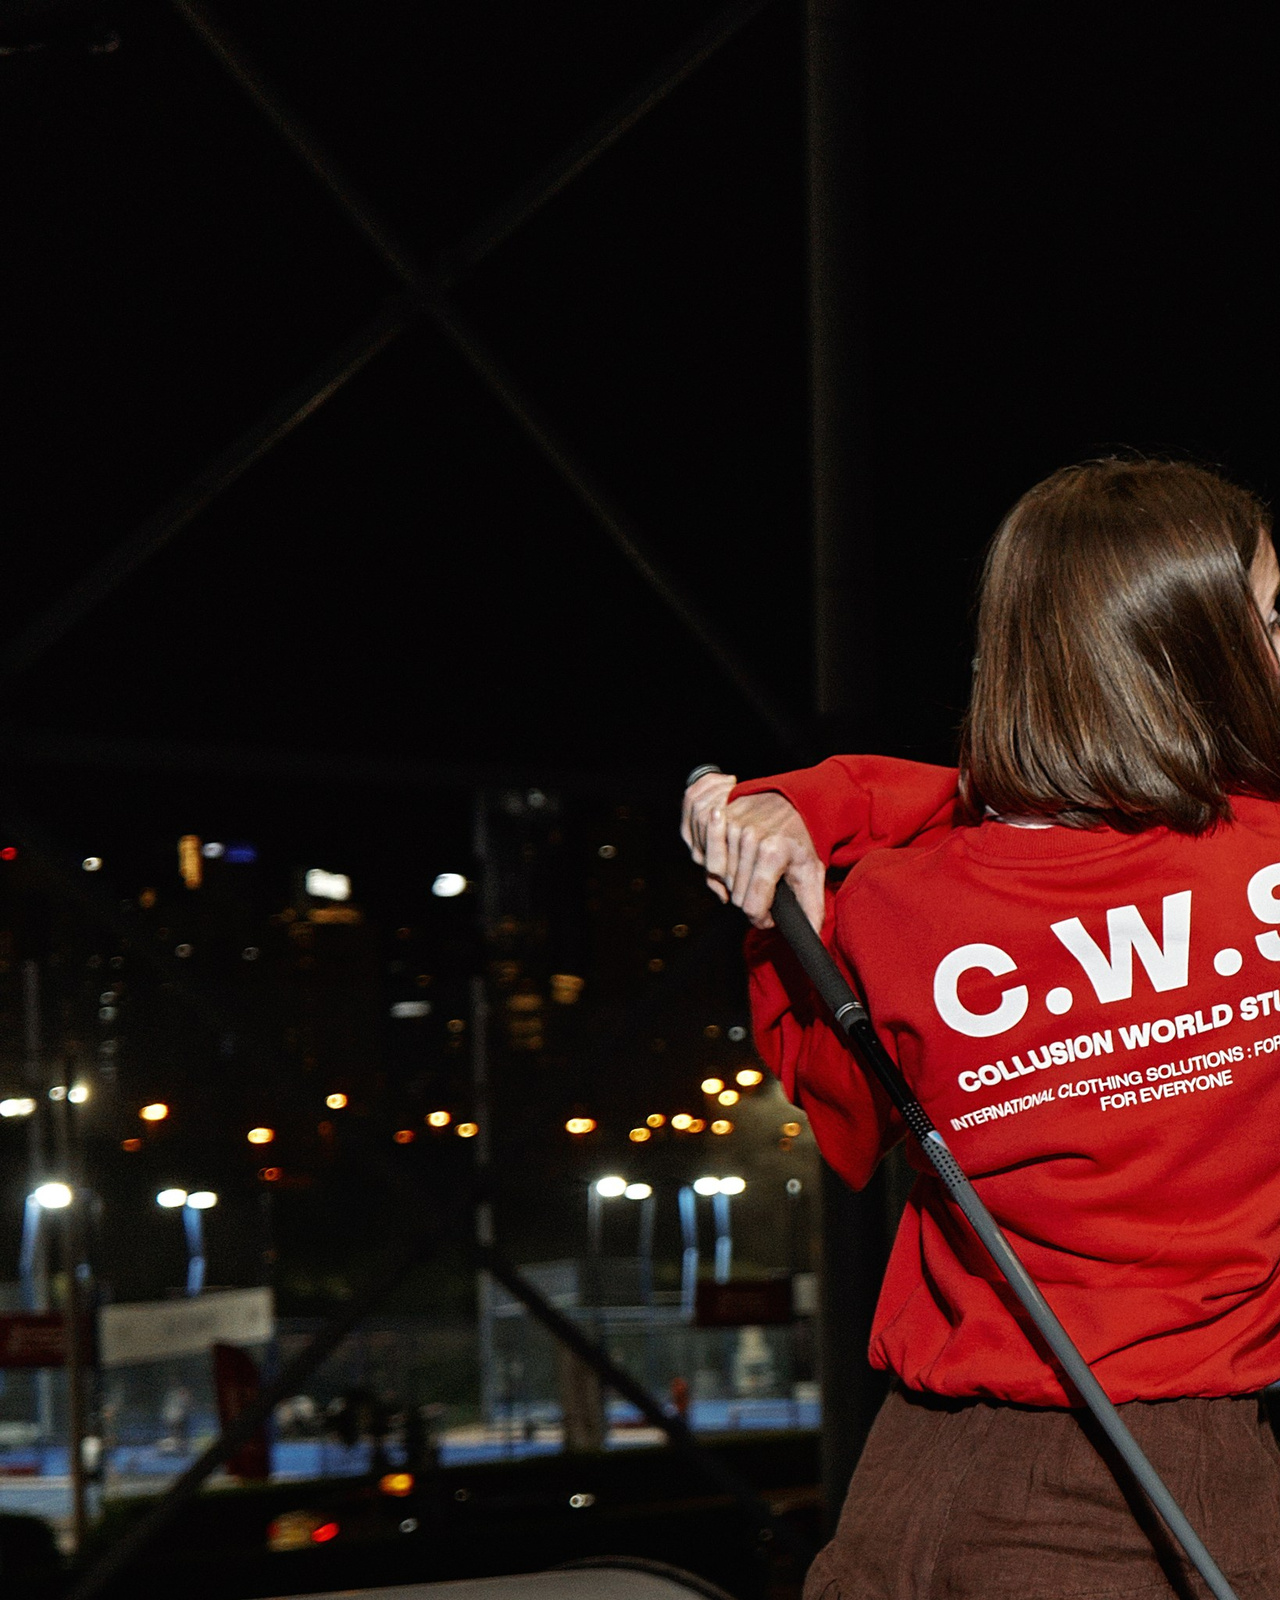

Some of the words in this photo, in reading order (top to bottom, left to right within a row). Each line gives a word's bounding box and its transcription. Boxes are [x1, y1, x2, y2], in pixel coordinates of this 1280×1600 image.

[950, 1088, 1056, 1132] INTERNATIONAL
[1057, 1070, 1144, 1099] CLOTHING
[1145, 1045, 1245, 1082] SOLUTIONS
[957, 1029, 1114, 1093] COLLUSION
[1118, 1003, 1234, 1051] WORLD
[1099, 1090, 1138, 1112] FOR
[1139, 1068, 1234, 1104] EVERYONE
